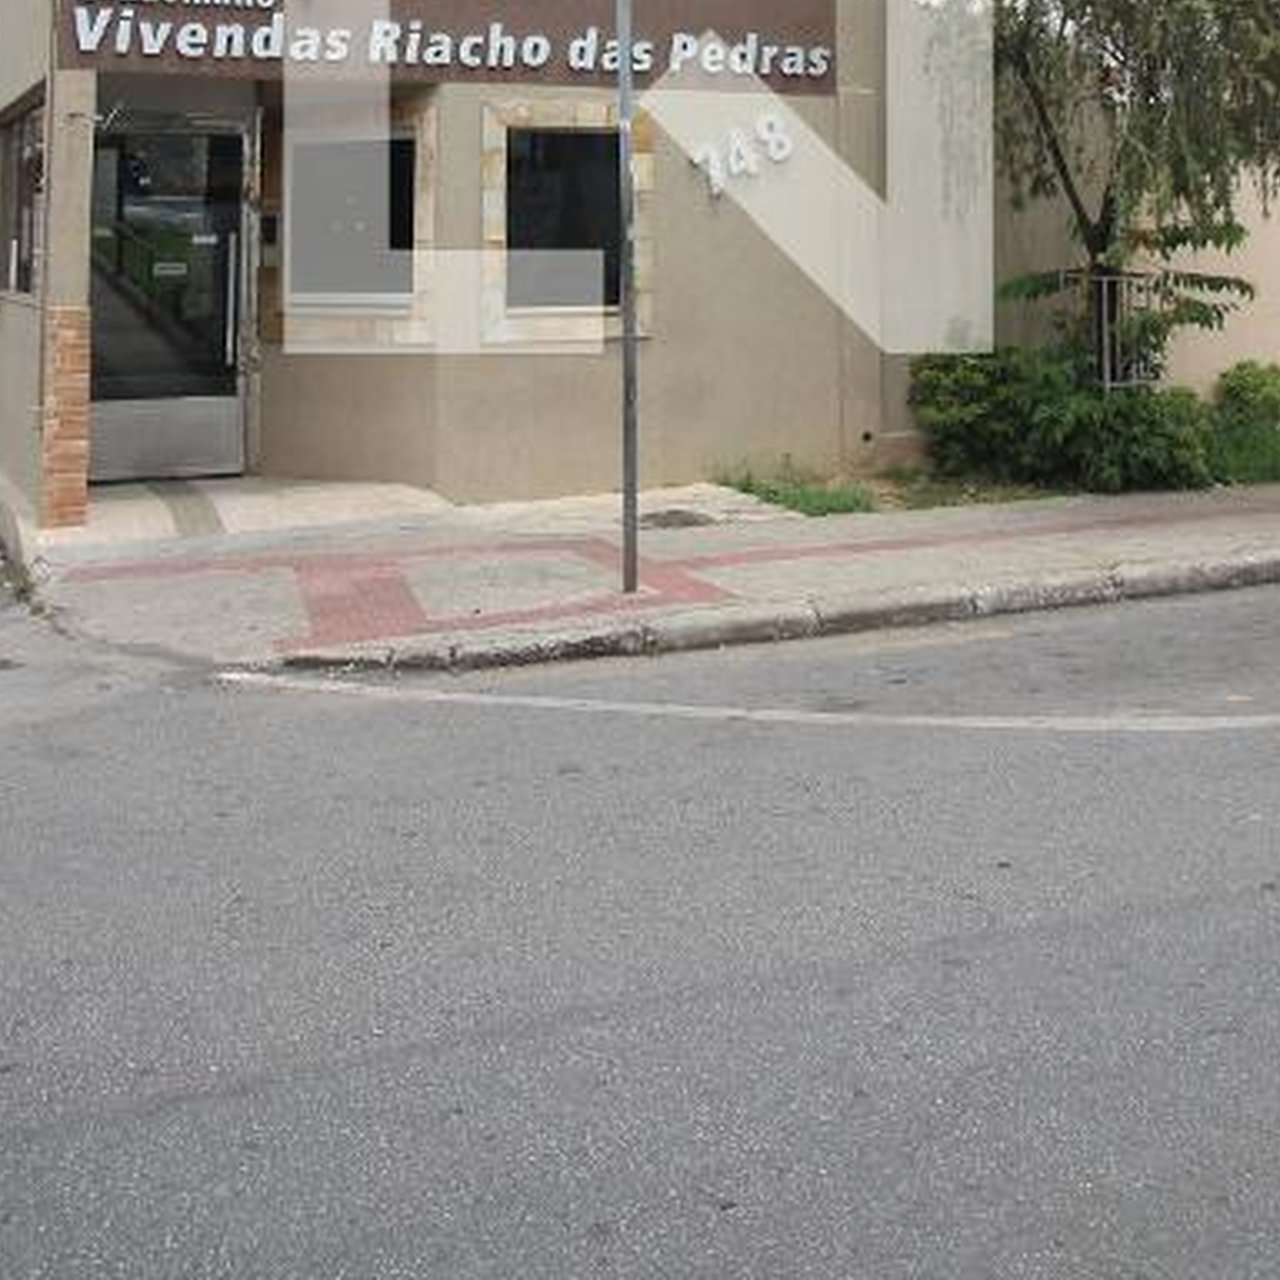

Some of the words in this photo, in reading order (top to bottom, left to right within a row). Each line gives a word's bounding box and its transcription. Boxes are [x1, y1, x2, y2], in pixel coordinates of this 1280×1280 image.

[73, 5, 352, 62] Vivendas
[370, 19, 552, 69] Riacho
[569, 26, 655, 72] das
[670, 31, 832, 77] Pedras
